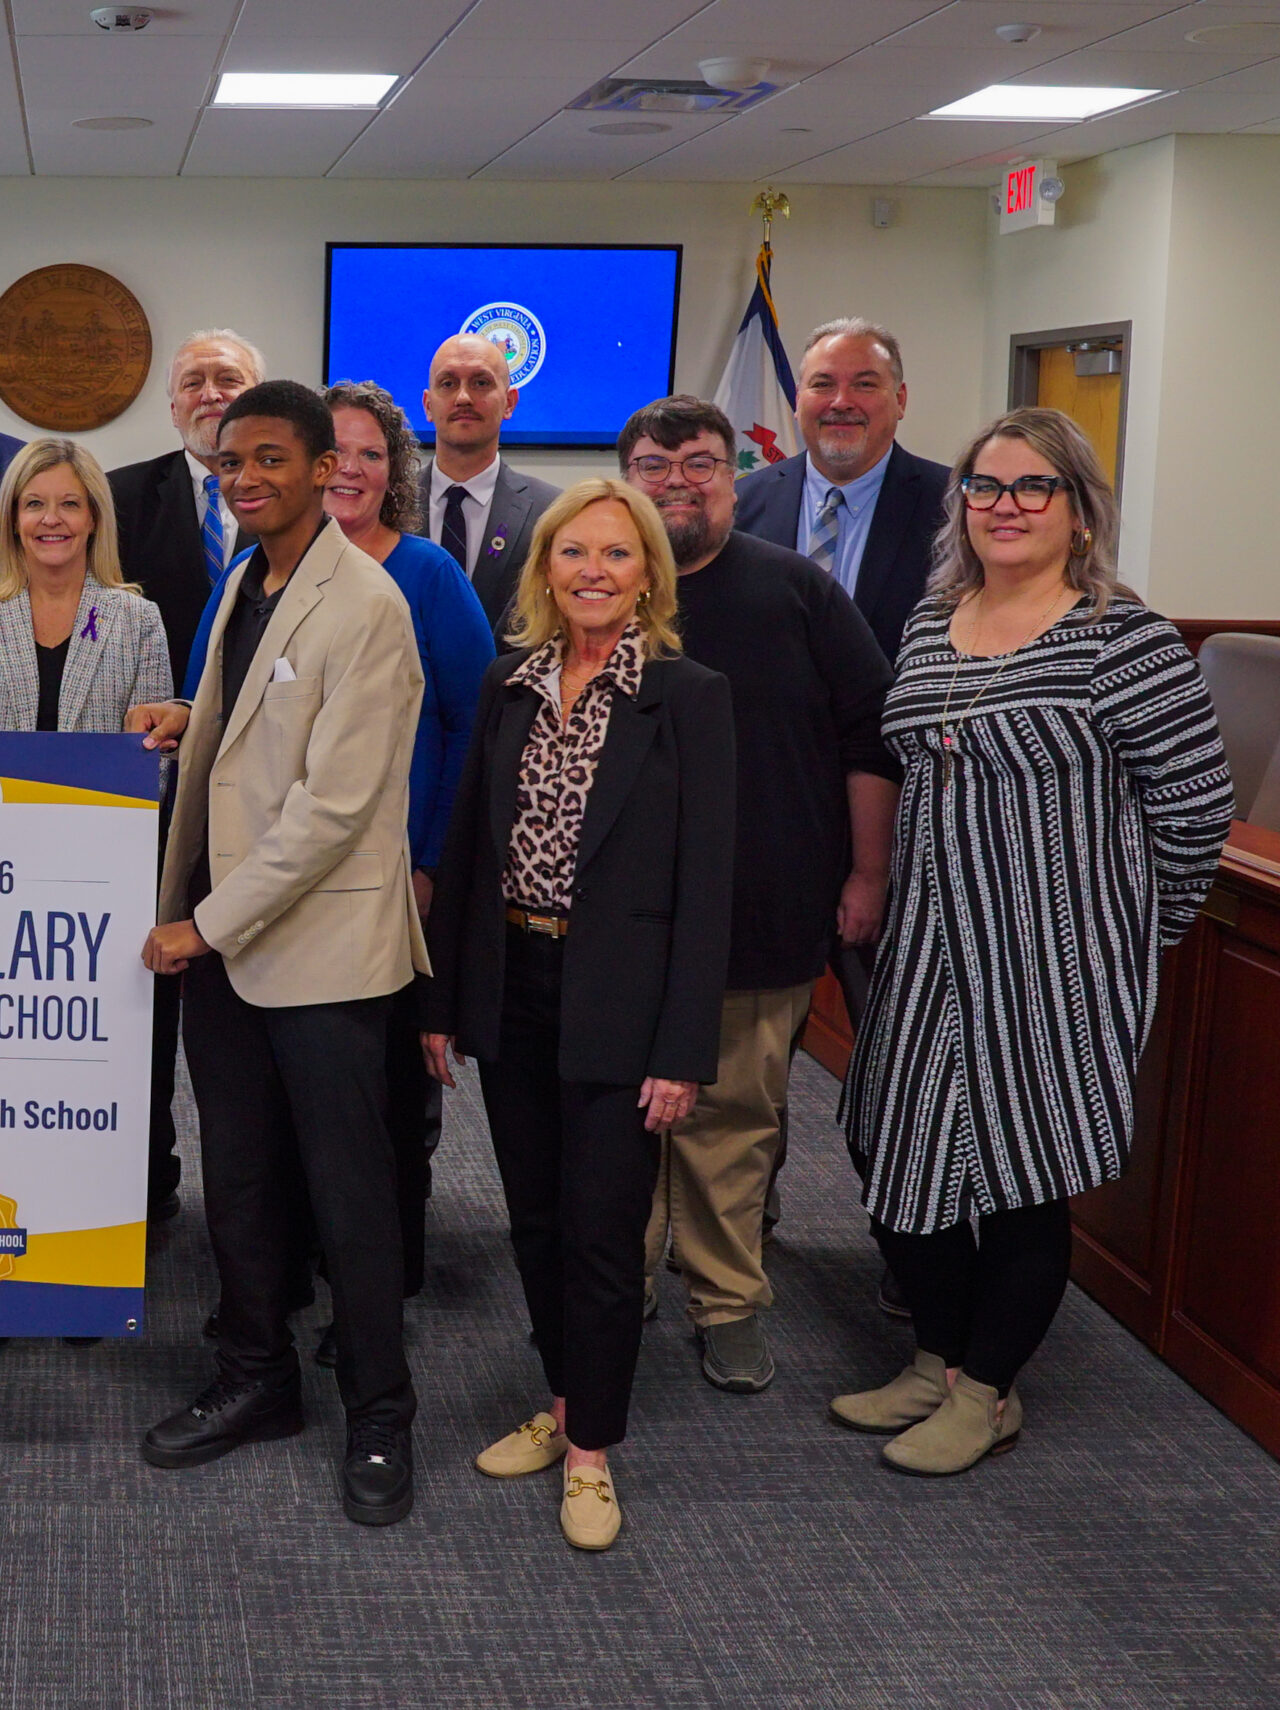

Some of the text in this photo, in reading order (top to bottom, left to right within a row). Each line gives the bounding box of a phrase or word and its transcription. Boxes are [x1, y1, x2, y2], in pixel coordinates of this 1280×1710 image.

[1007, 166, 1036, 214] EXIT
[45, 273, 100, 290] WEST
[471, 308, 532, 330] WEST VIRGINIA
[24, 1100, 118, 1131] School
